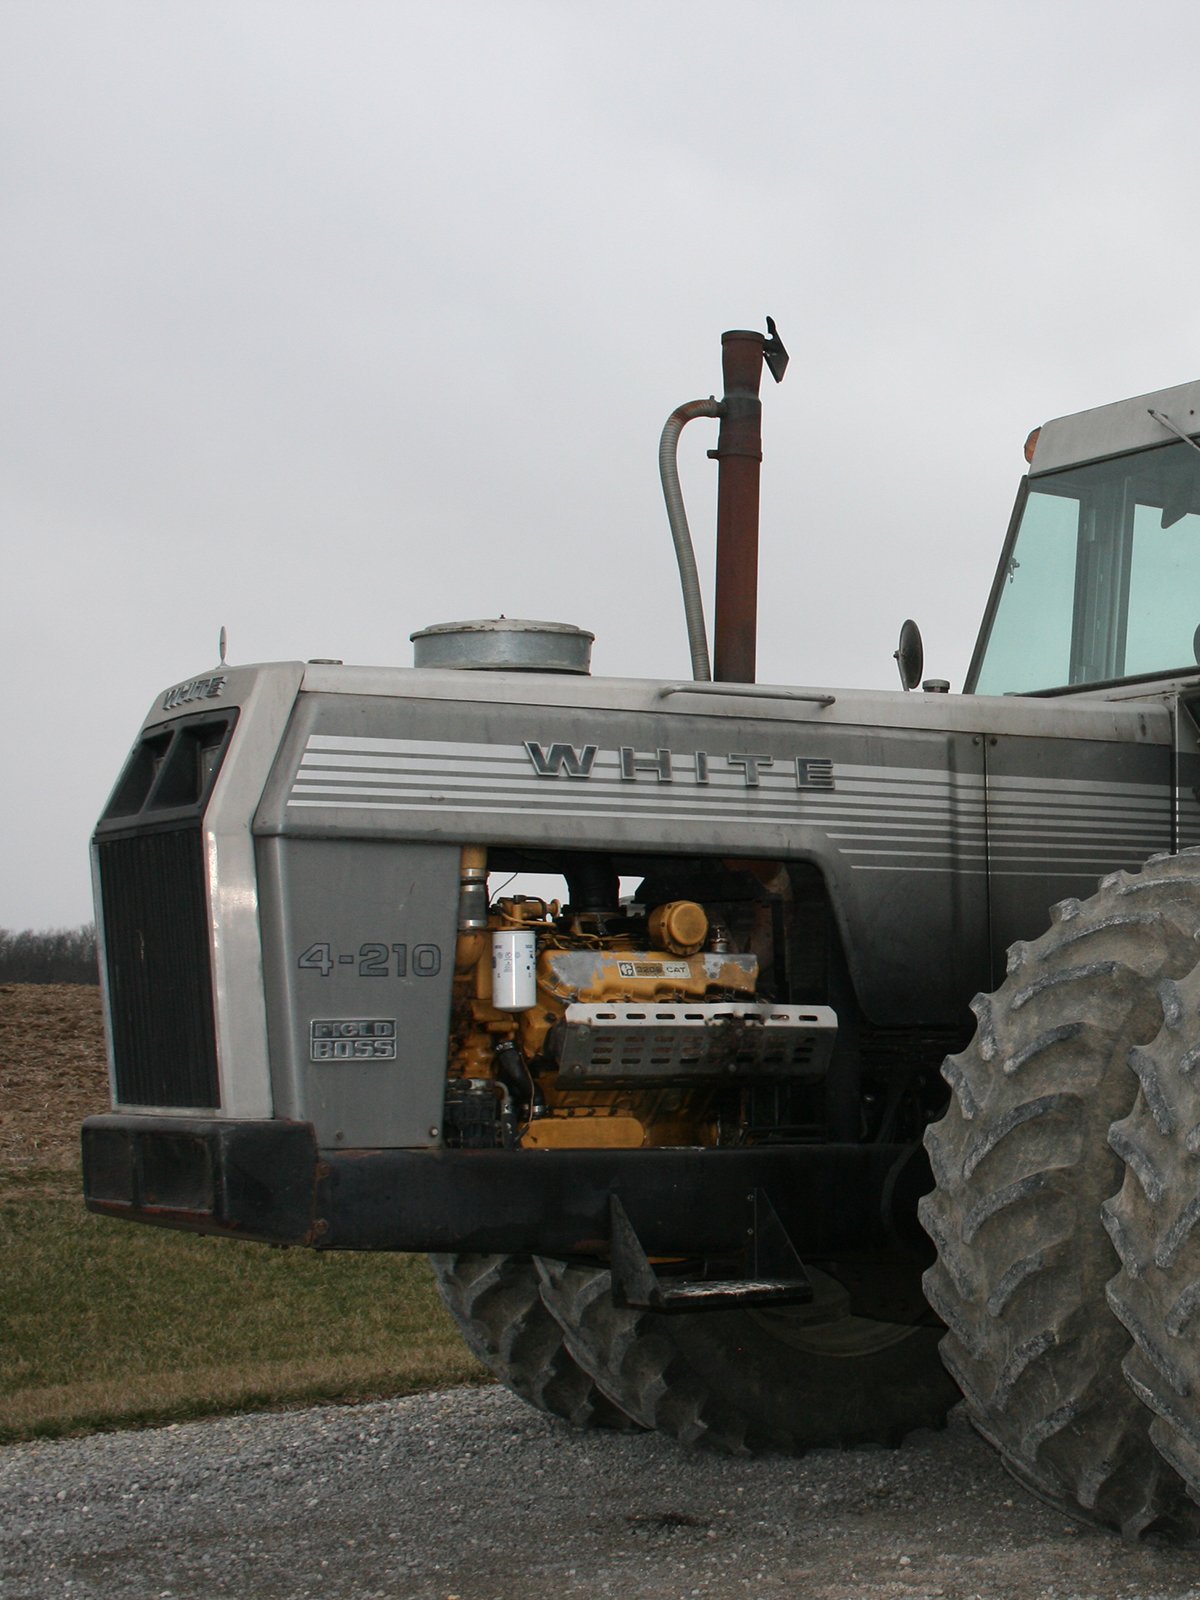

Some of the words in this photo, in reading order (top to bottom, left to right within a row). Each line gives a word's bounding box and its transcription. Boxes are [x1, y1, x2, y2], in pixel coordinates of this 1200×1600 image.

[162, 677, 228, 710] WHITE
[523, 741, 834, 789] WHITE
[298, 942, 442, 977] 4-210
[314, 1022, 393, 1037] FIELD
[313, 1040, 394, 1058] BOSS
